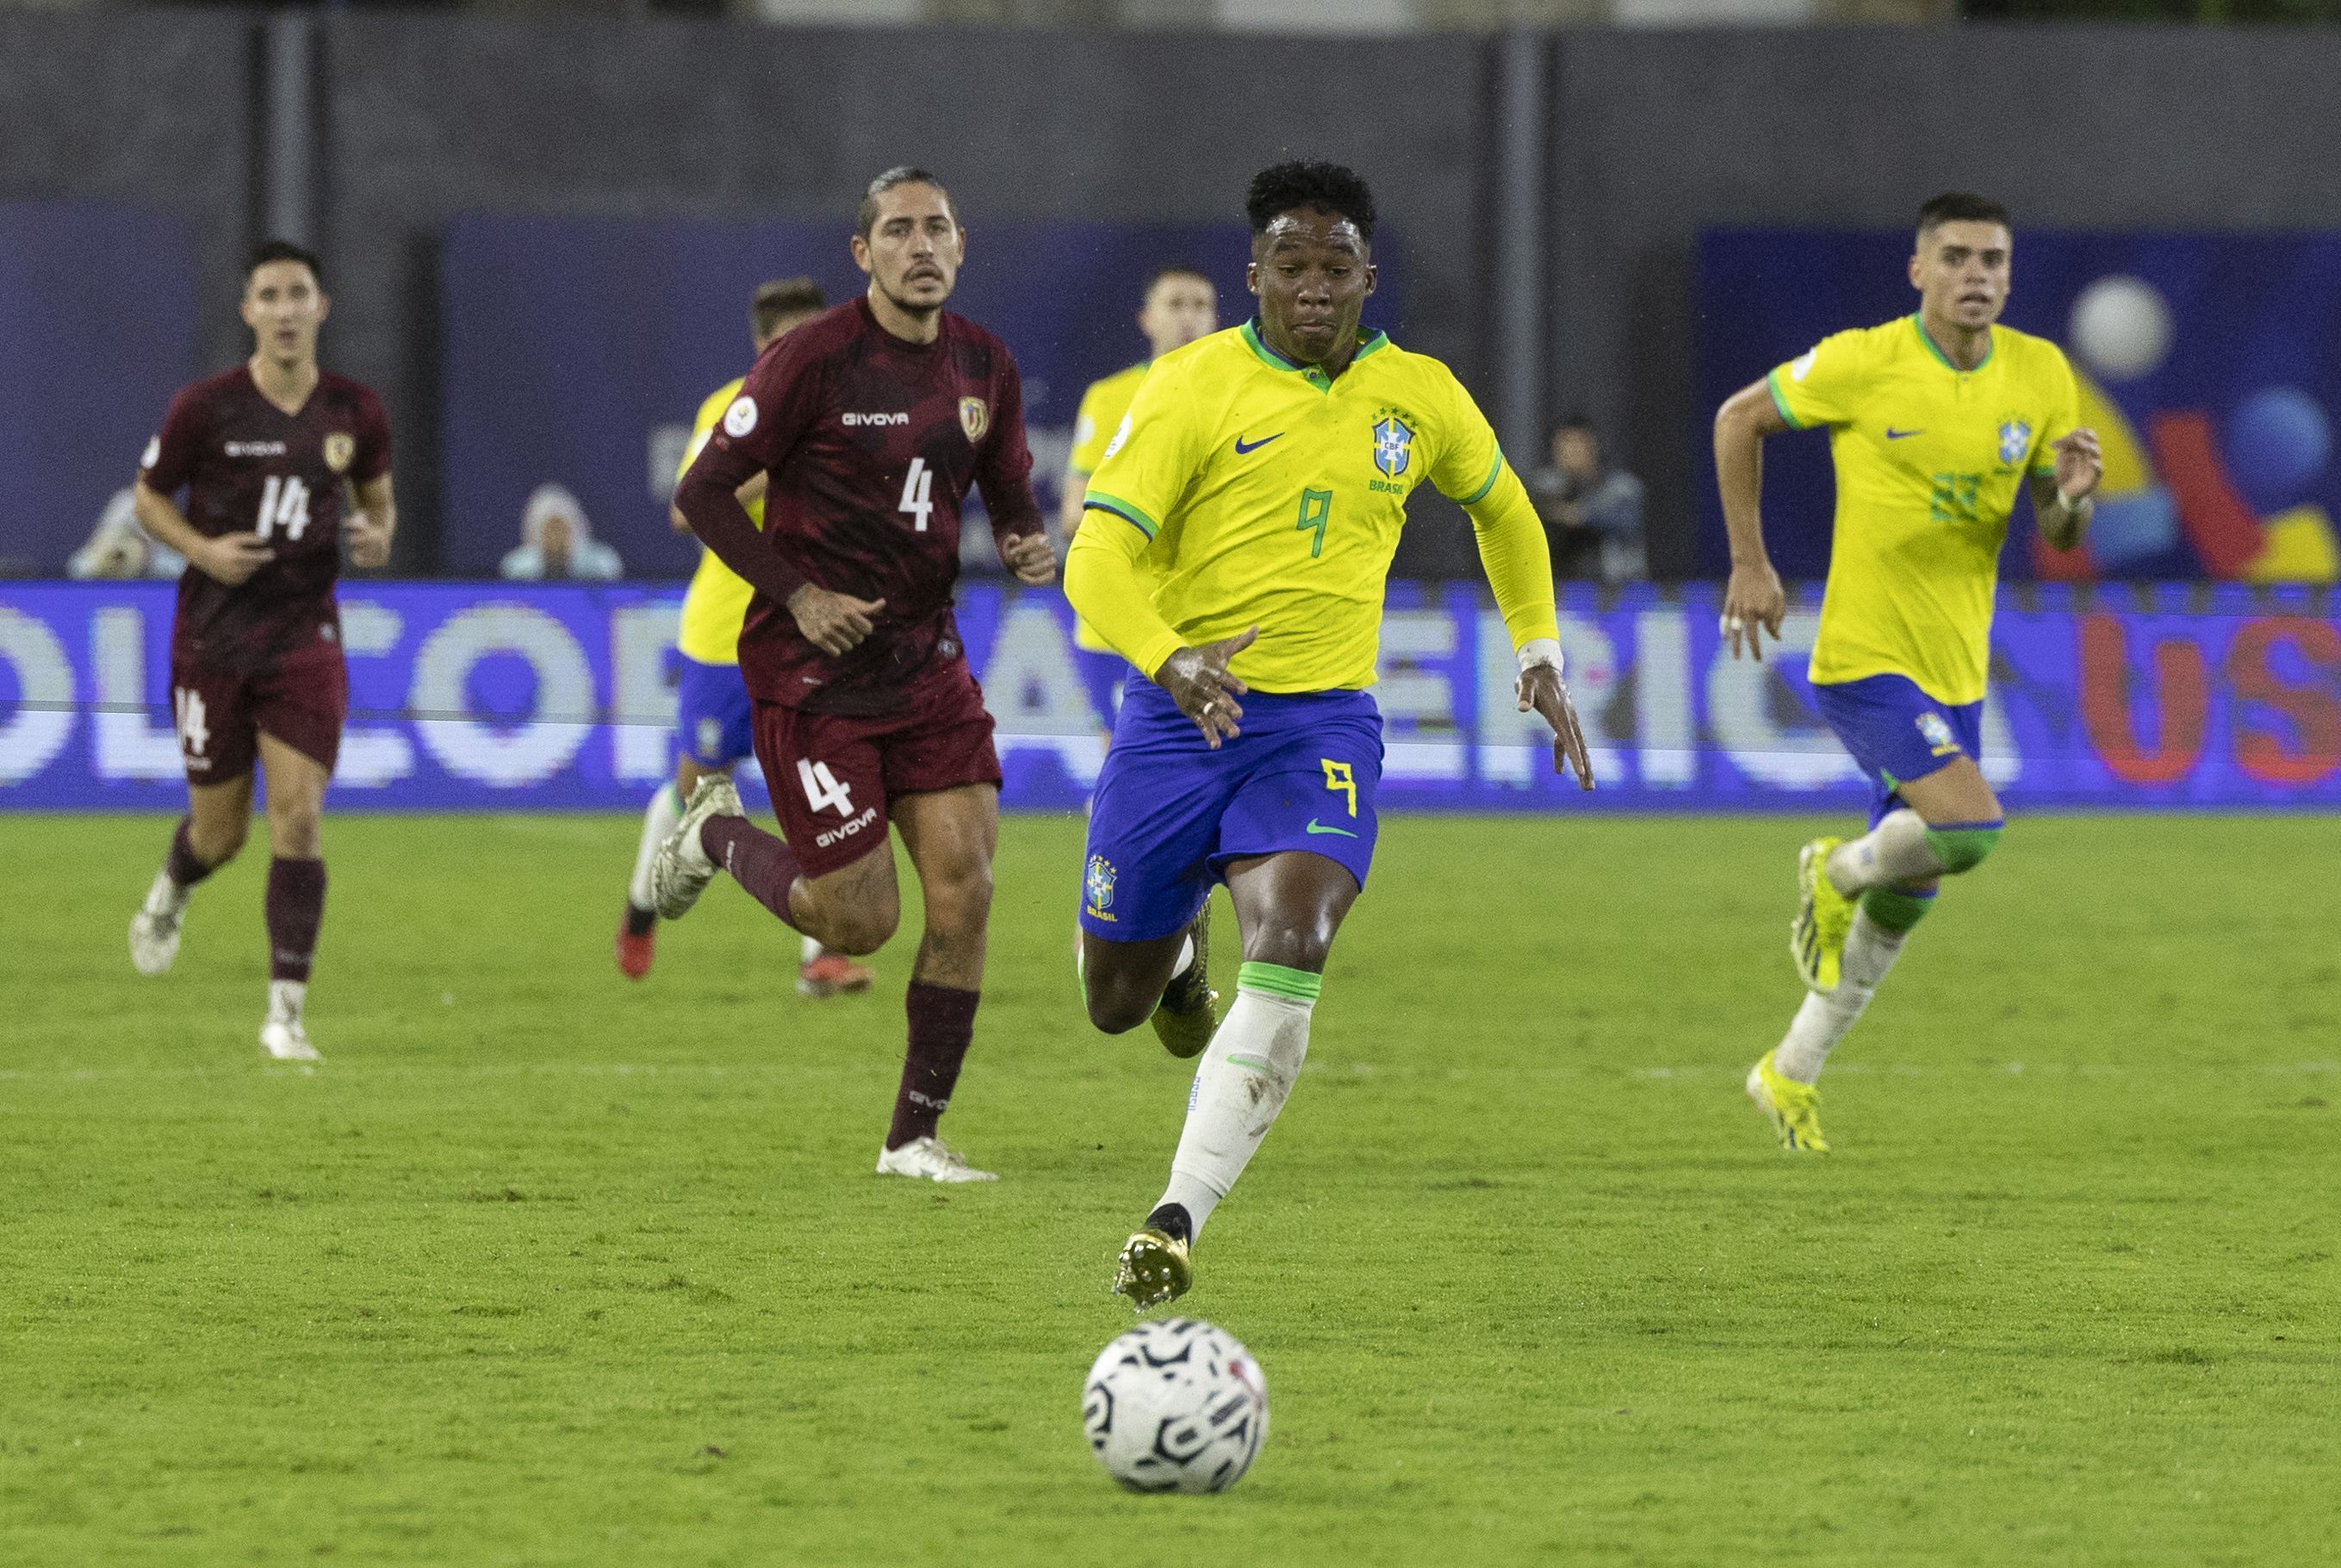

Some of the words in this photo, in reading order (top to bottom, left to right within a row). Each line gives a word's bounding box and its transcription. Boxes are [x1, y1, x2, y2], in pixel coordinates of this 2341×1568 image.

[841, 412, 909, 426] GIVOVA
[1384, 442, 1400, 450] CBF
[256, 474, 311, 541] 14
[898, 457, 934, 532] 4
[1369, 479, 1404, 495] BRASIL
[1297, 487, 1333, 559] 9
[175, 686, 211, 756] 14
[797, 758, 854, 818] 4
[1320, 758, 1357, 818] 9
[816, 808, 877, 847] GIVOVA
